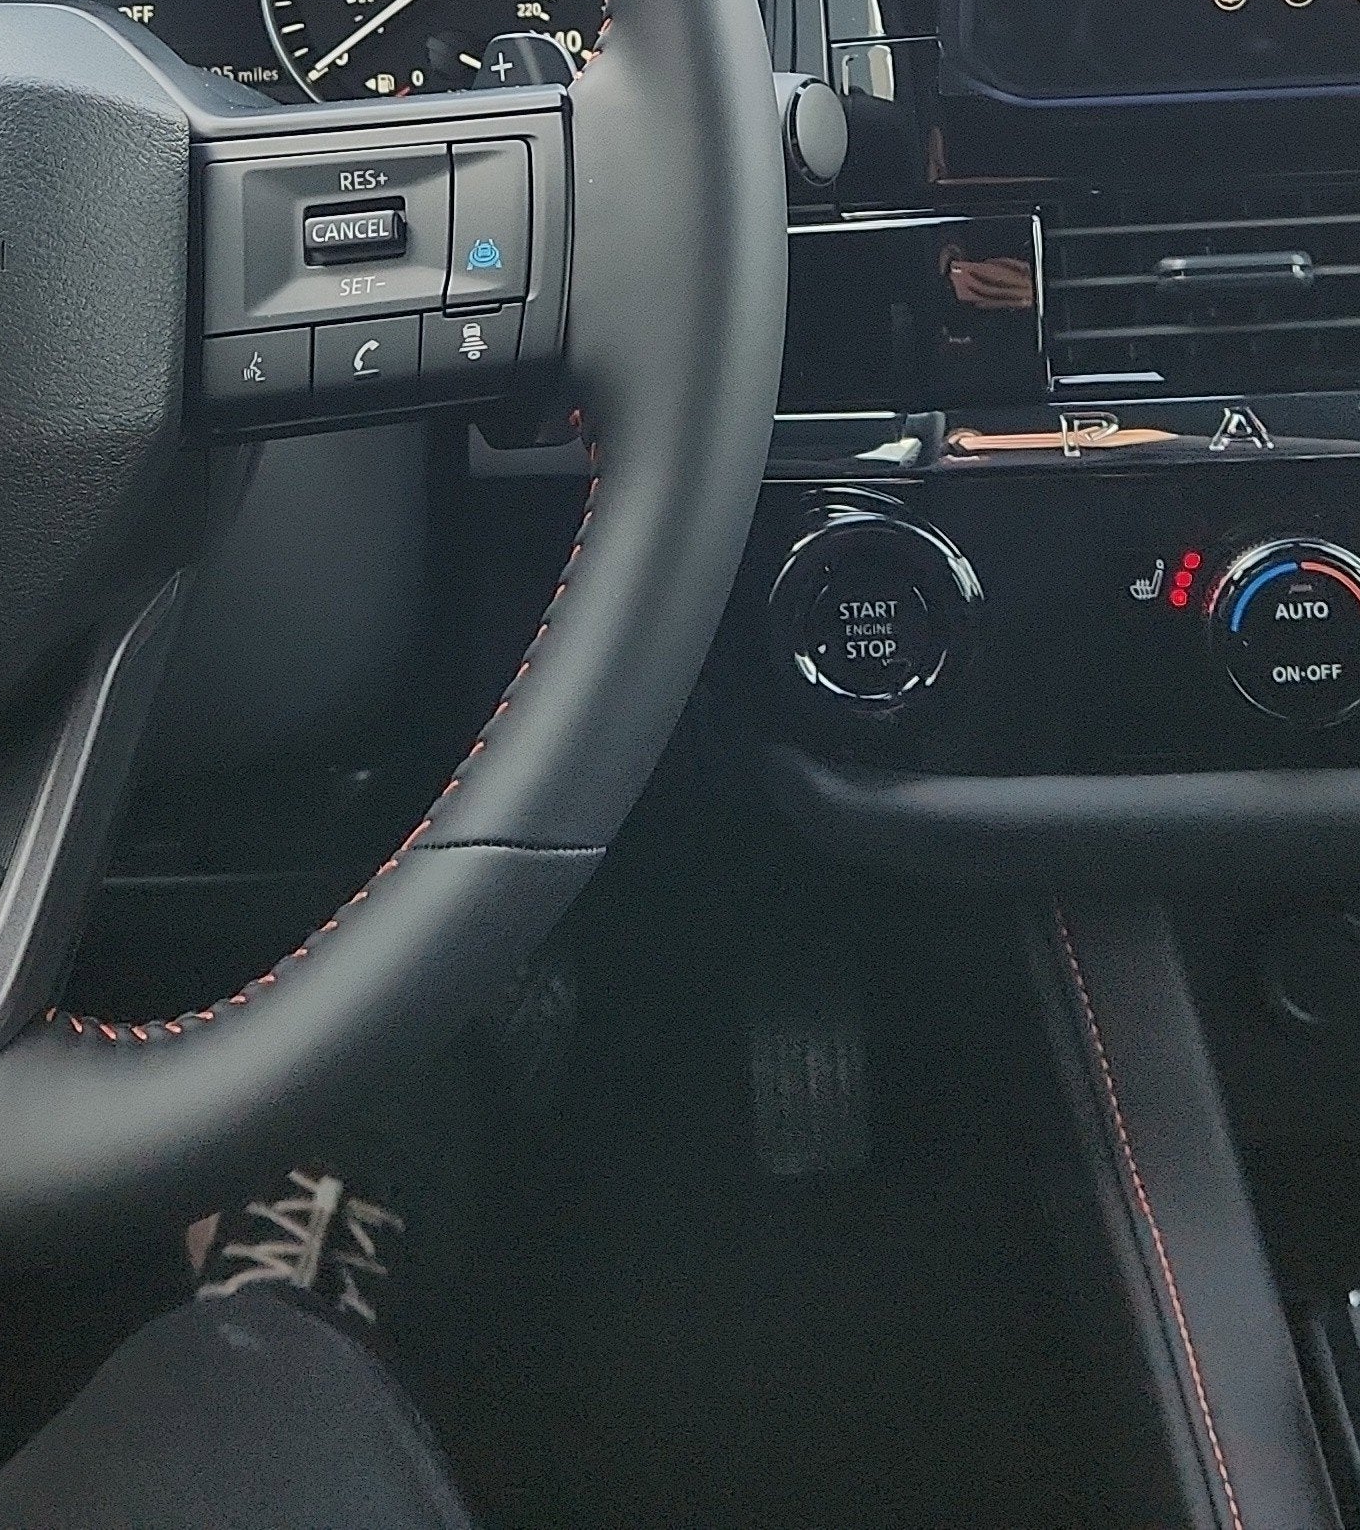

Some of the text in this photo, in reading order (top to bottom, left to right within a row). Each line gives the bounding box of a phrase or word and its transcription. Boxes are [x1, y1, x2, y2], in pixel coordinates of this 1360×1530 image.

[517, 3, 541, 17] 220
[238, 67, 279, 83] miles
[339, 171, 389, 191] RES+
[311, 217, 390, 243] CANCEL
[839, 600, 898, 620] START
[1275, 601, 1329, 621] AUTO
[845, 622, 893, 636] ENGINE
[846, 639, 897, 660] STOP
